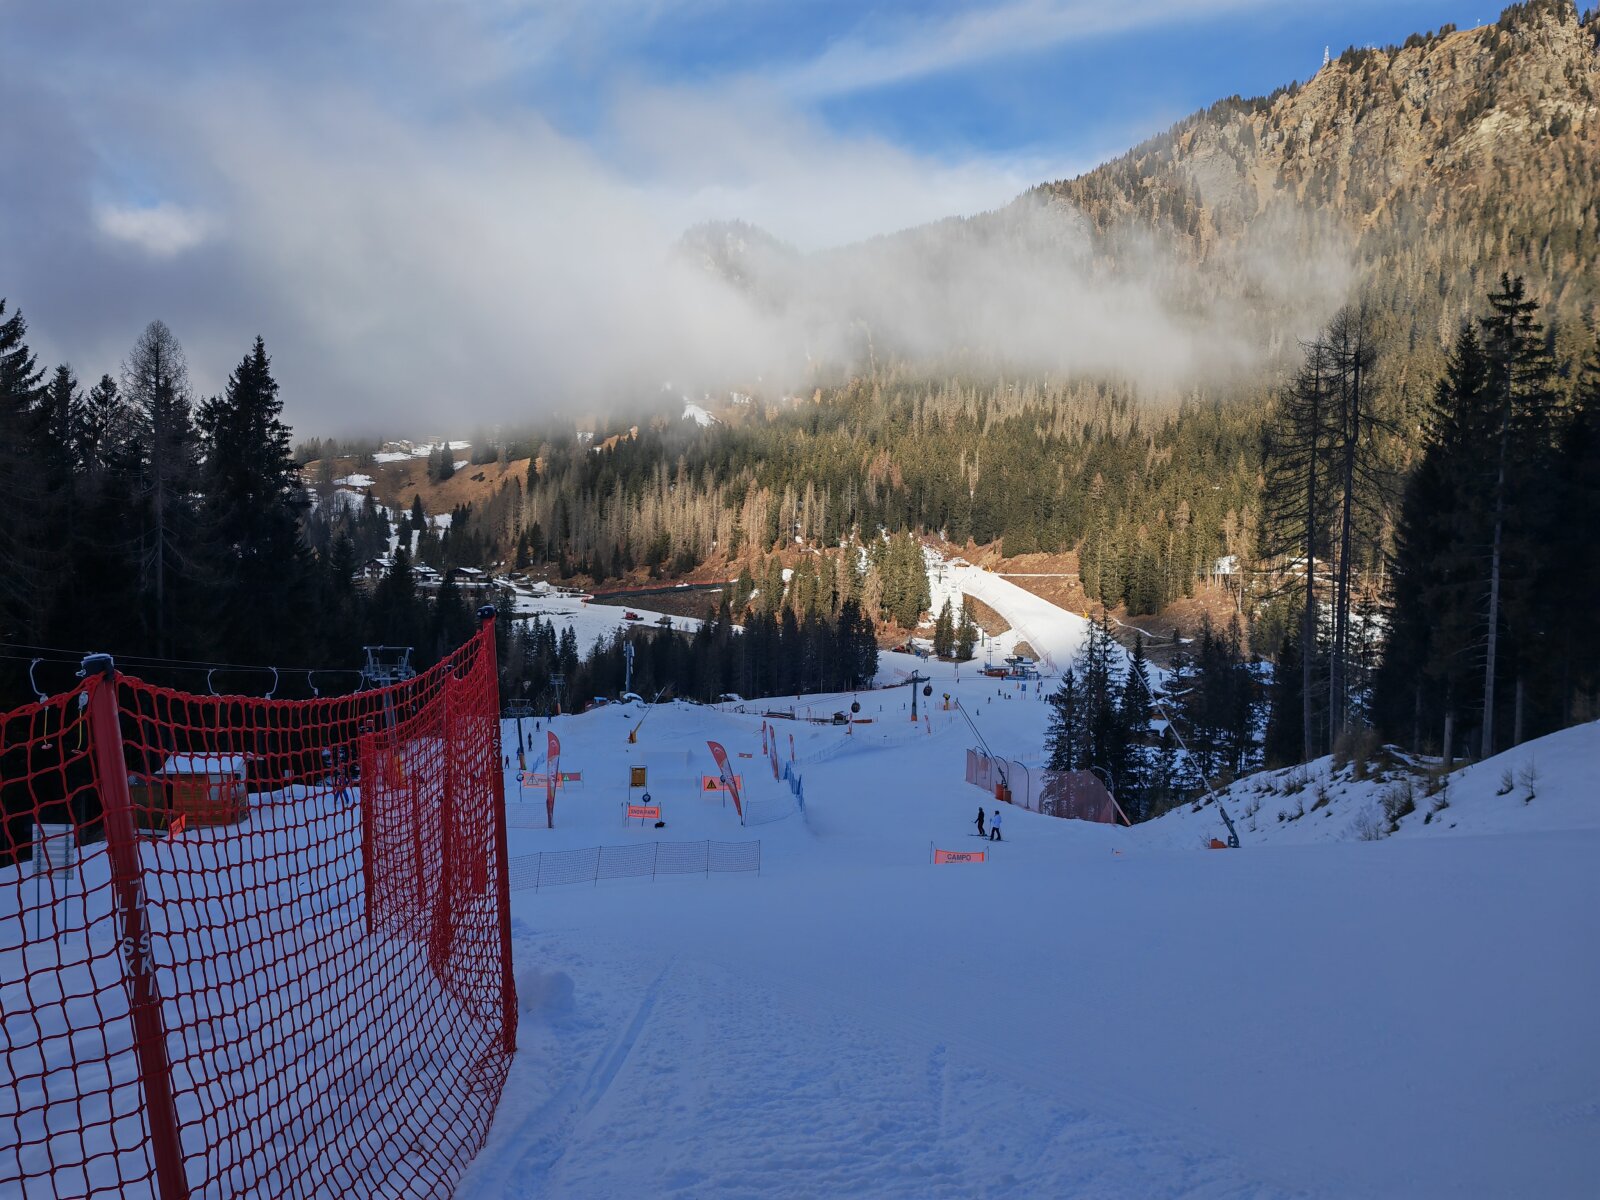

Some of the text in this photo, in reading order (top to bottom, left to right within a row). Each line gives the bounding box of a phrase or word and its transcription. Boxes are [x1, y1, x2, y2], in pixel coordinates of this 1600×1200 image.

[947, 853, 971, 861] CAMPO
[117, 893, 136, 1000] LISKI
[135, 890, 154, 997] LISKI
